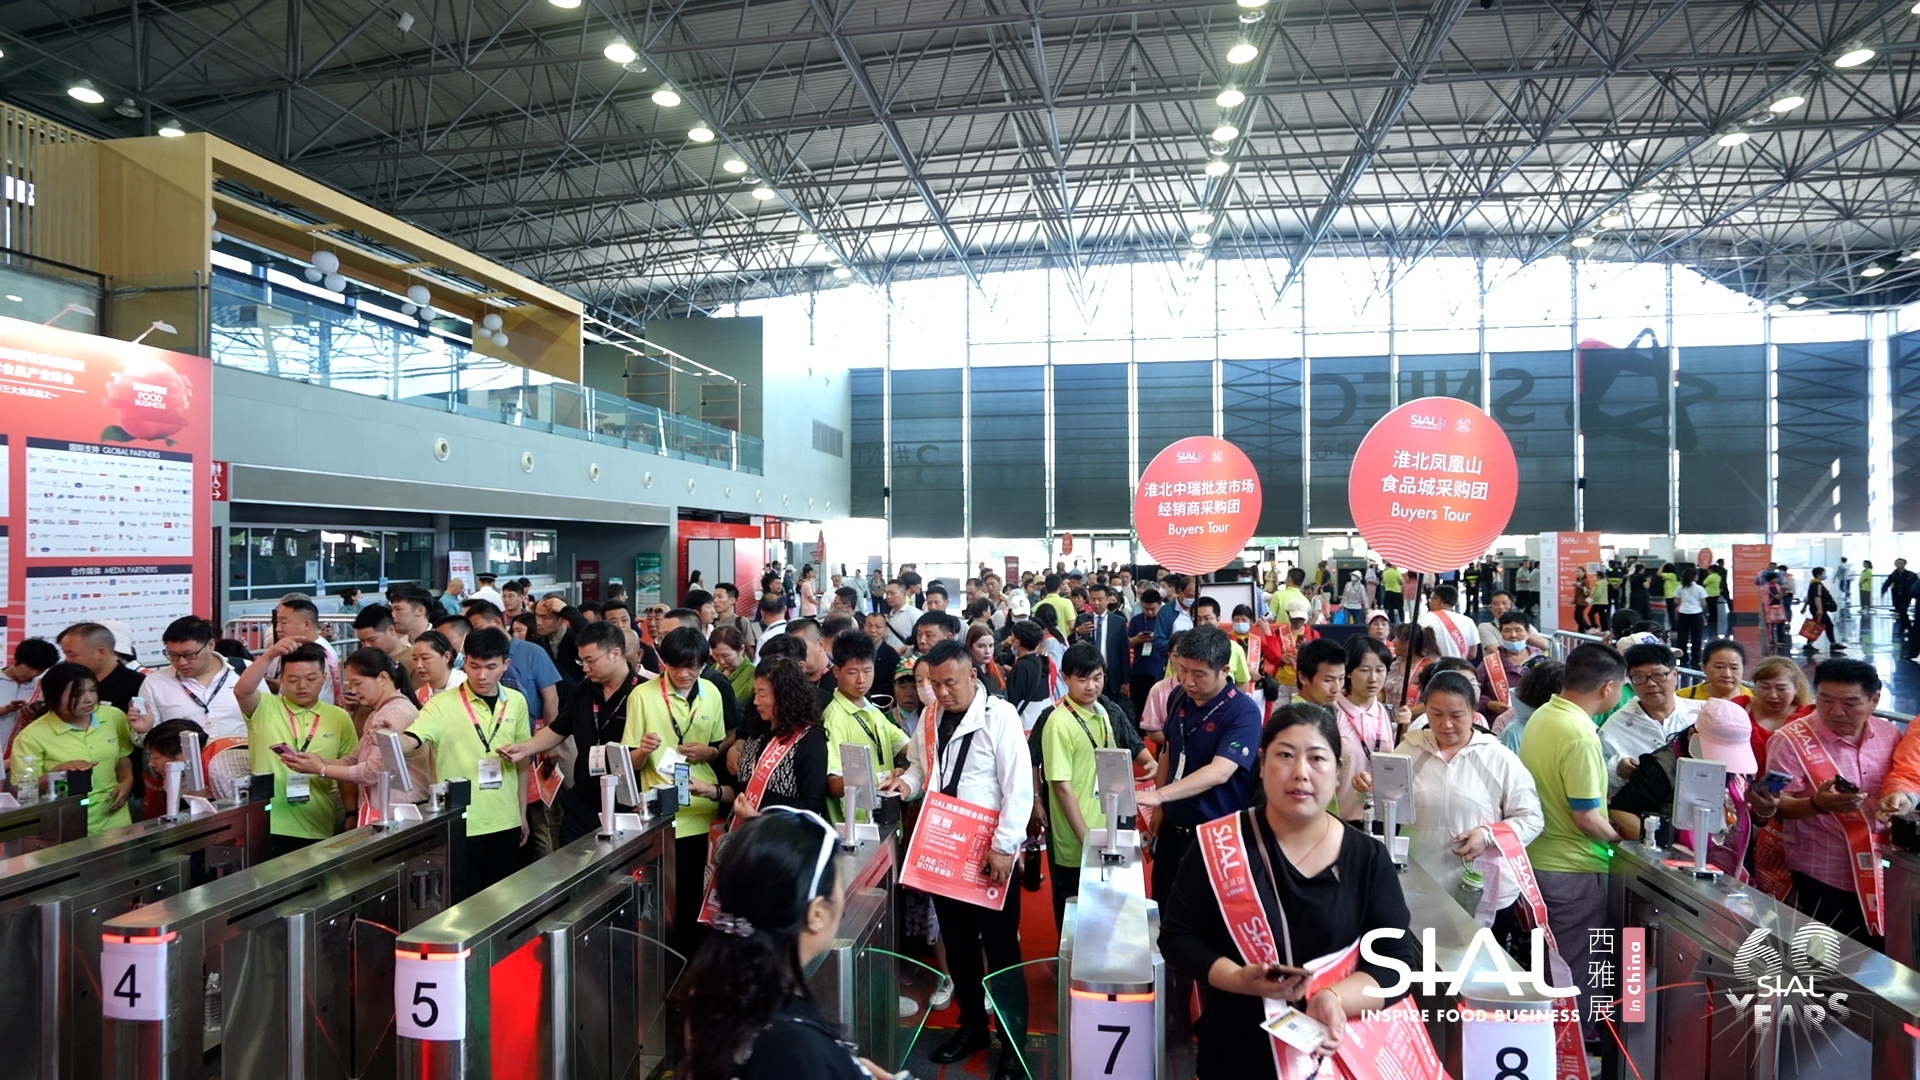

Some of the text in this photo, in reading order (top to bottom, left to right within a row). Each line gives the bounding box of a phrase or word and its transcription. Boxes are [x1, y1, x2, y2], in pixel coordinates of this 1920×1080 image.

[138, 391, 163, 403] FOOD
[1411, 415, 1438, 427] SIAL
[102, 446, 128, 456] GLOBAL
[130, 449, 160, 459] PARTNERS
[1177, 452, 1198, 460] SIAL
[1392, 450, 1482, 475] 淮北凤凰山
[1144, 479, 1255, 497] 淮北中瑞批发市场
[1381, 474, 1489, 501] 食品城采购团
[1158, 499, 1240, 517] 经销商采购团
[1391, 502, 1472, 522] Buyers Tour
[1168, 522, 1230, 538] Buyers Tour
[71, 567, 101, 576] 合作媒体
[127, 566, 158, 574] PARTNERS
[1789, 723, 1817, 755] SIAL
[762, 744, 786, 770] SIAL
[1213, 825, 1240, 879] SIAL
[1513, 855, 1534, 896] SIAL
[1243, 916, 1279, 967] SIA
[114, 964, 141, 1007] 4
[411, 982, 438, 1027] 5
[1098, 1024, 1131, 1074] 7
[1494, 1047, 1529, 1080] 8
